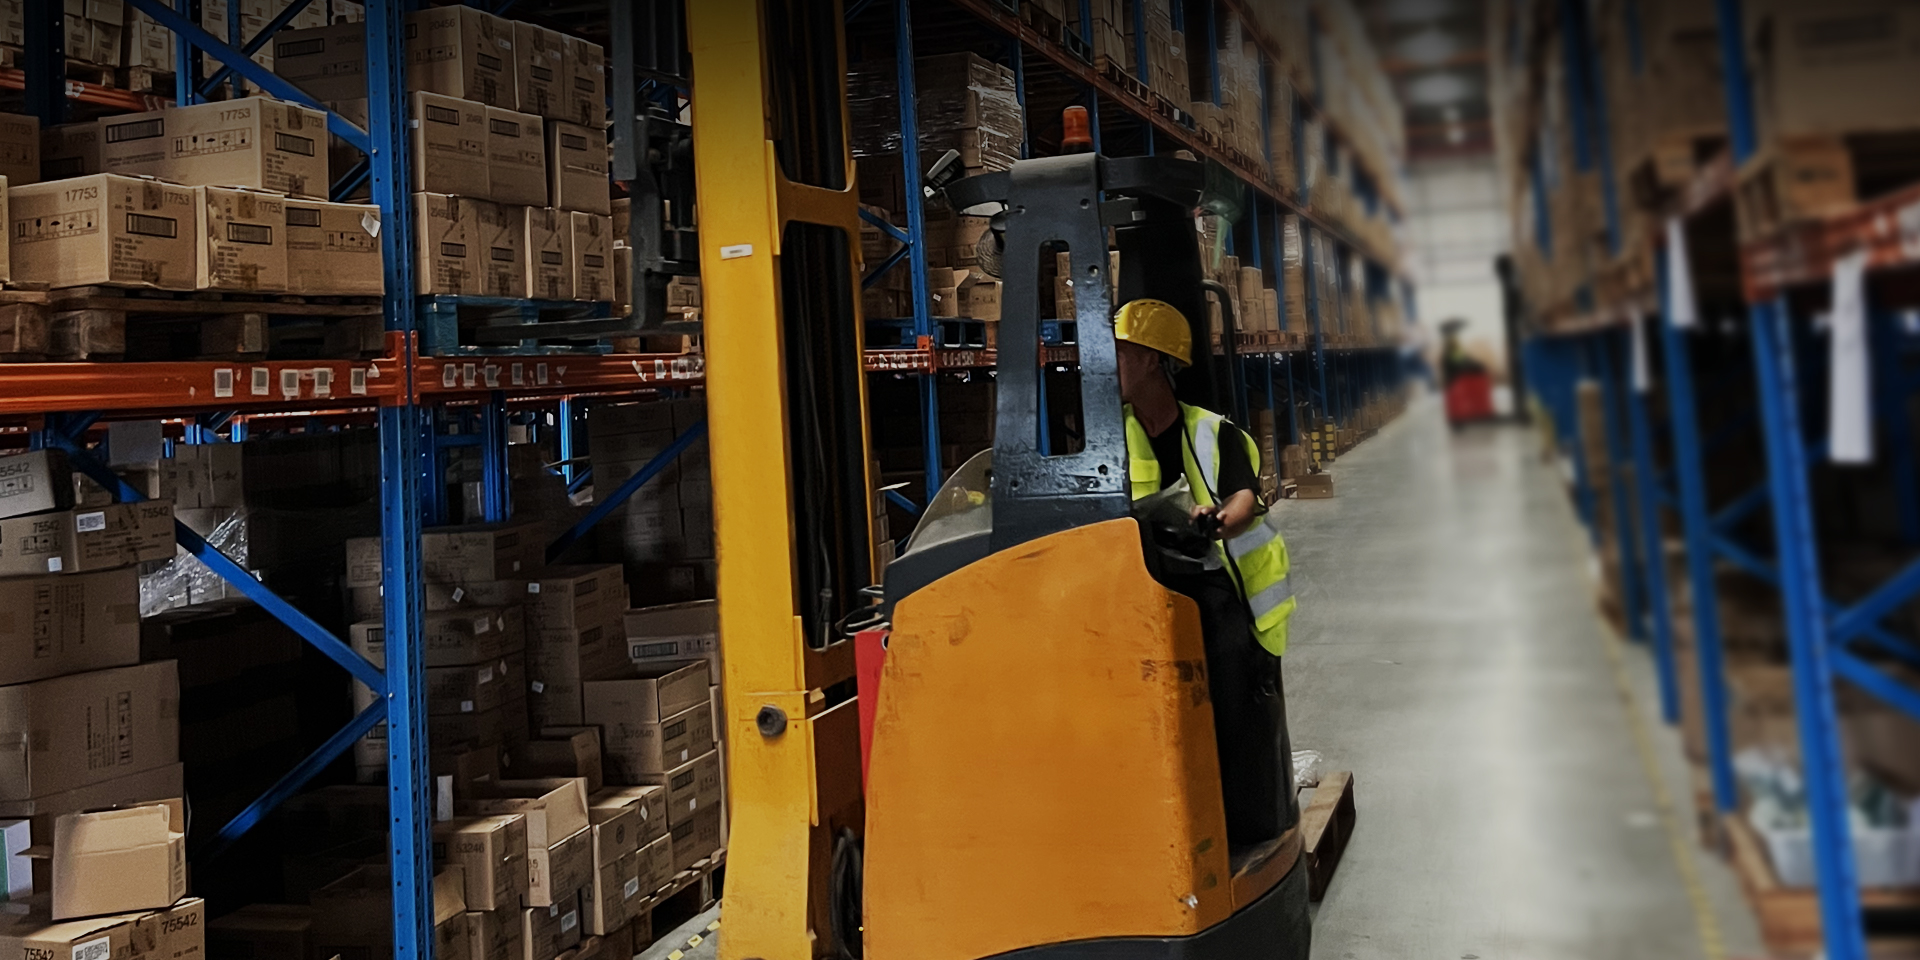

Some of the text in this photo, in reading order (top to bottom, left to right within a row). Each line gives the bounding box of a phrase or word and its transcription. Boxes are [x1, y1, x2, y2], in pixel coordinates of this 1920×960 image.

[219, 107, 251, 123] 17753
[303, 114, 324, 129] 17753
[4, 122, 33, 136] 17753
[65, 187, 98, 202] 17753
[164, 191, 190, 206] 17753
[257, 200, 283, 214] 17753
[141, 506, 170, 518] 75542
[33, 520, 61, 533] 75542
[161, 912, 198, 935] 75542
[23, 947, 55, 960] 75542
